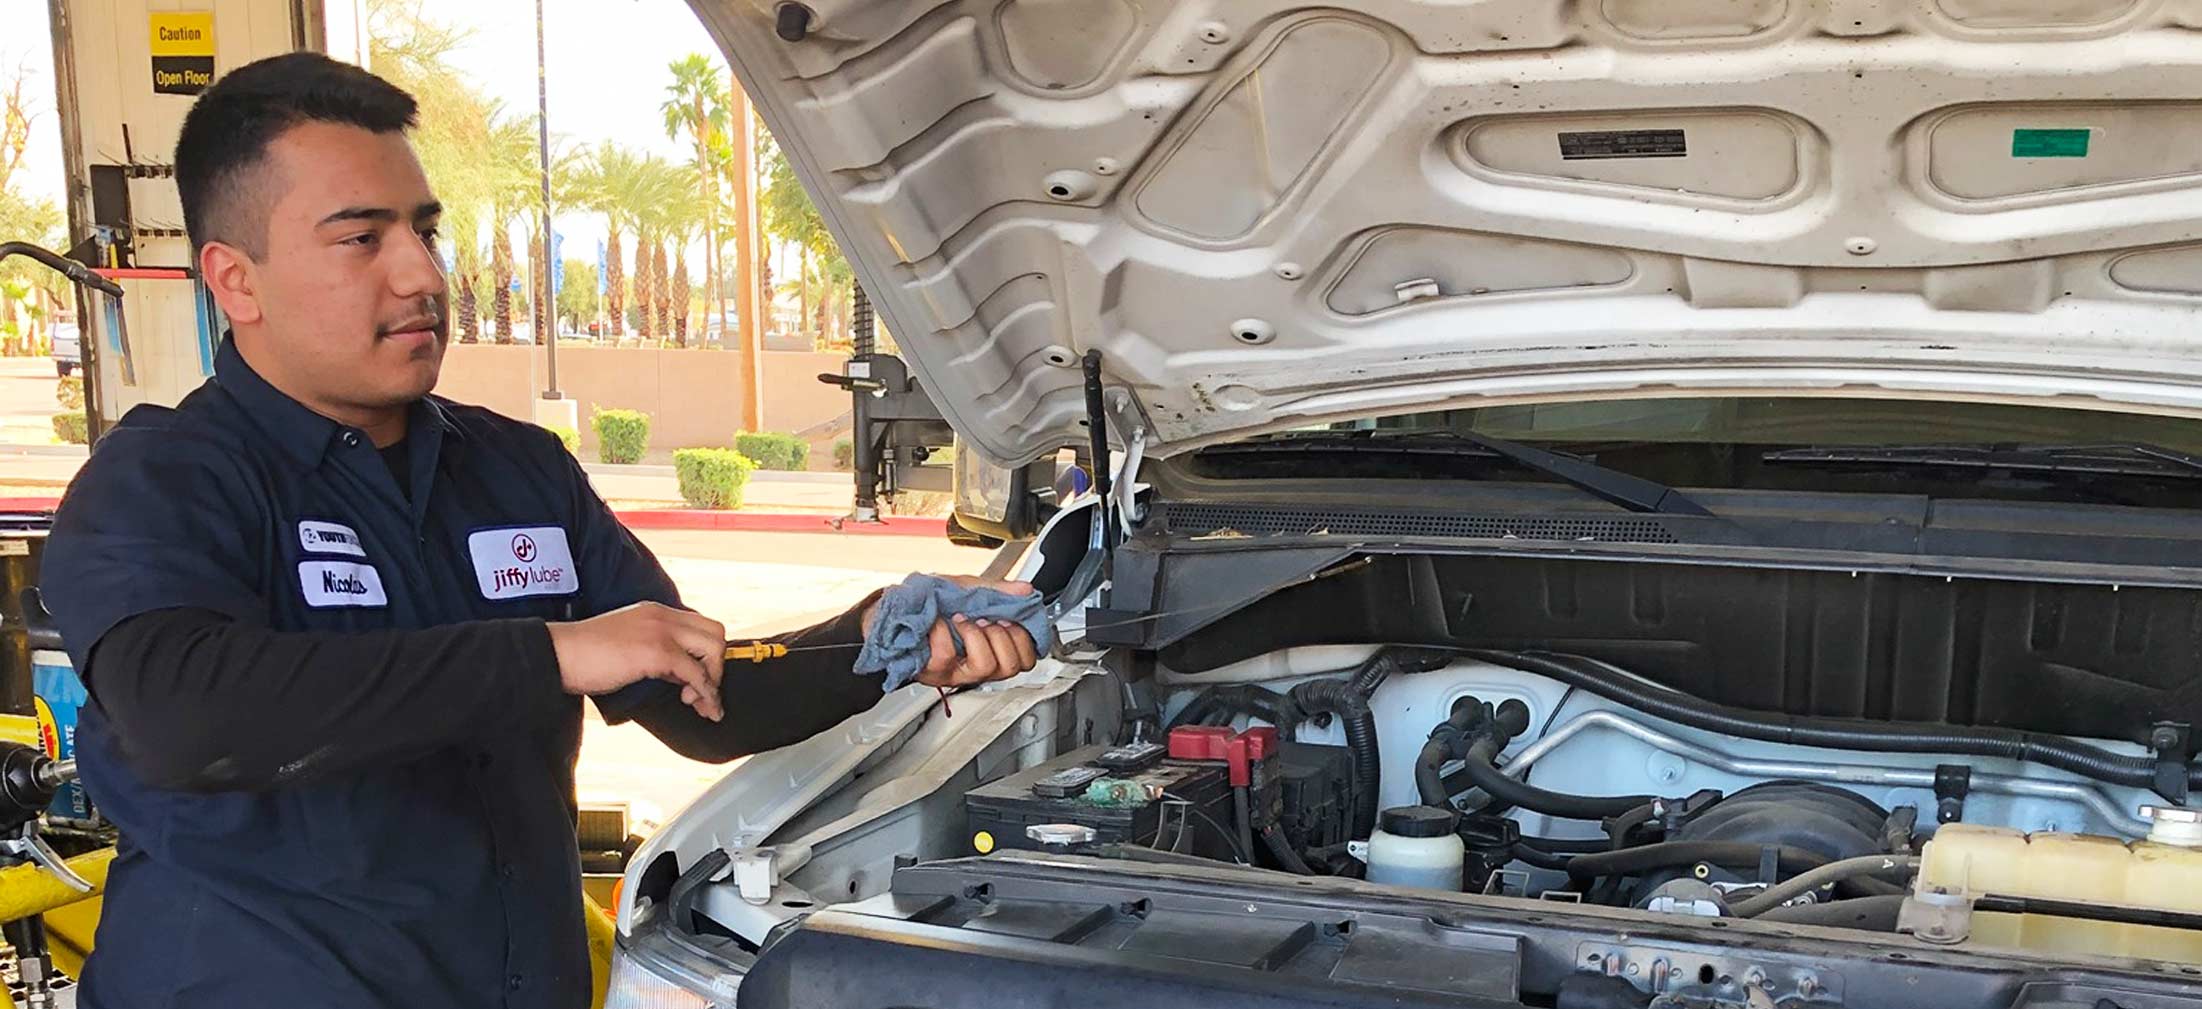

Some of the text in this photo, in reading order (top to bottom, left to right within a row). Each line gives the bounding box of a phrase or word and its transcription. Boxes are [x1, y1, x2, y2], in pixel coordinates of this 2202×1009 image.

[159, 26, 202, 41] Caution
[156, 69, 210, 87] Open Floor
[322, 570, 368, 595] Nicolas
[493, 567, 529, 592] jiffy
